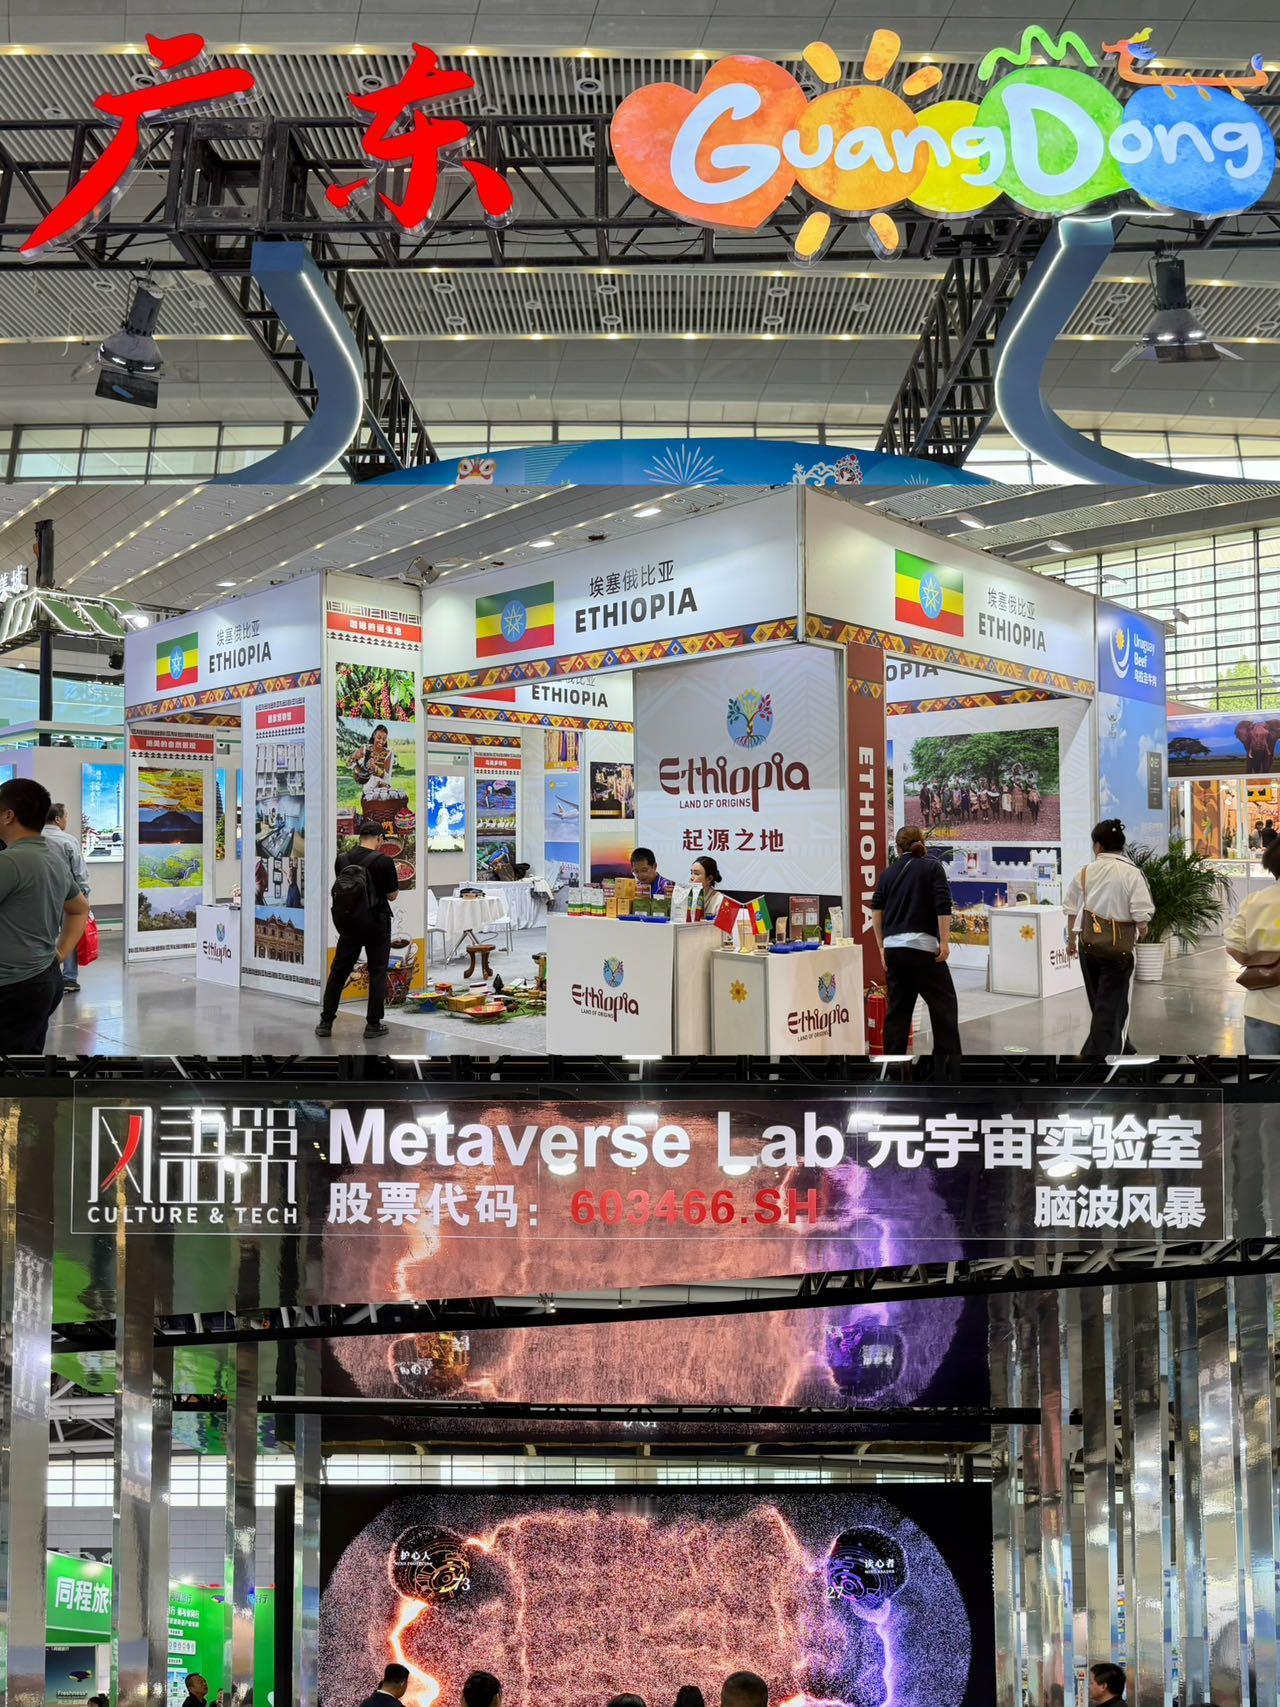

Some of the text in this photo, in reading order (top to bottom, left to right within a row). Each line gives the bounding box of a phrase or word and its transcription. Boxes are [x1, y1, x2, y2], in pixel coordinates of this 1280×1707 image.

[20, 33, 514, 254] 广东
[670, 82, 1263, 204] GuangDong
[588, 559, 675, 598] 埃塞俄比亚
[575, 587, 698, 633] ETHIOPIA
[987, 586, 1036, 620] 埃塞俄比亚
[216, 619, 261, 647] 埃塞俄比亚
[978, 612, 1046, 652] ETHIOPIA
[1133, 632, 1155, 657] Uruguay
[209, 641, 272, 673] ETHIOPIA
[1133, 651, 1148, 668] Beef
[532, 684, 609, 708] ETHIOPIA
[659, 751, 812, 813] Ethiopia
[679, 798, 751, 809] LAND OF ORIGINS
[682, 828, 785, 852] 起源之地
[858, 746, 876, 934] ETHIOPIA
[571, 984, 639, 1022] Ethiopia
[787, 1004, 850, 1037] Ethiopia
[328, 1108, 1203, 1169] Metaverse Lab 元宇宙实验室
[87, 1206, 298, 1224] CULTURE & TECH
[570, 1188, 818, 1226] 603466.SH
[1033, 1184, 1206, 1229] 脑波风暴
[864, 1558, 895, 1569] 读心者
[55, 1576, 112, 1614] 同程旅
[827, 1586, 844, 1599] 27
